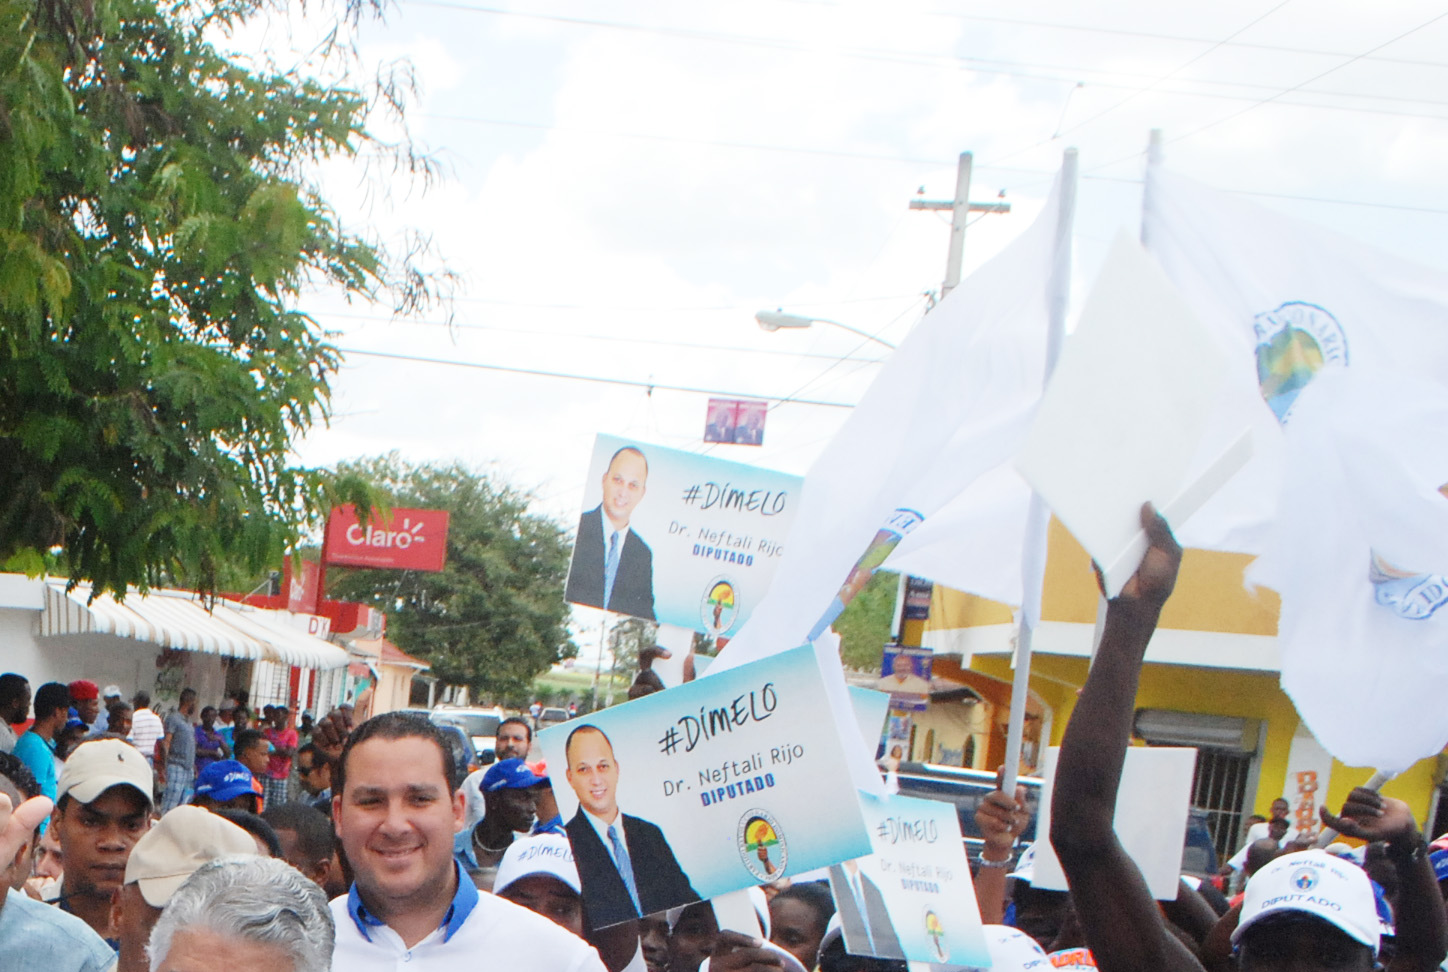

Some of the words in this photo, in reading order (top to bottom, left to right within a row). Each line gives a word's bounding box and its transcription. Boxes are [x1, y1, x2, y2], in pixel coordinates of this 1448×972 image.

[346, 522, 412, 549] Claro
[668, 520, 690, 537] Dr.
[697, 527, 752, 549] Neftali
[692, 543, 754, 567] DIPUTADO
[663, 778, 691, 797] Dr.
[699, 752, 763, 787] Neftali
[770, 744, 804, 765] Rijo
[700, 772, 776, 807] DIPUTADO
[901, 878, 941, 894] DIPUTADO
[1261, 894, 1342, 912] DIPUTADO
